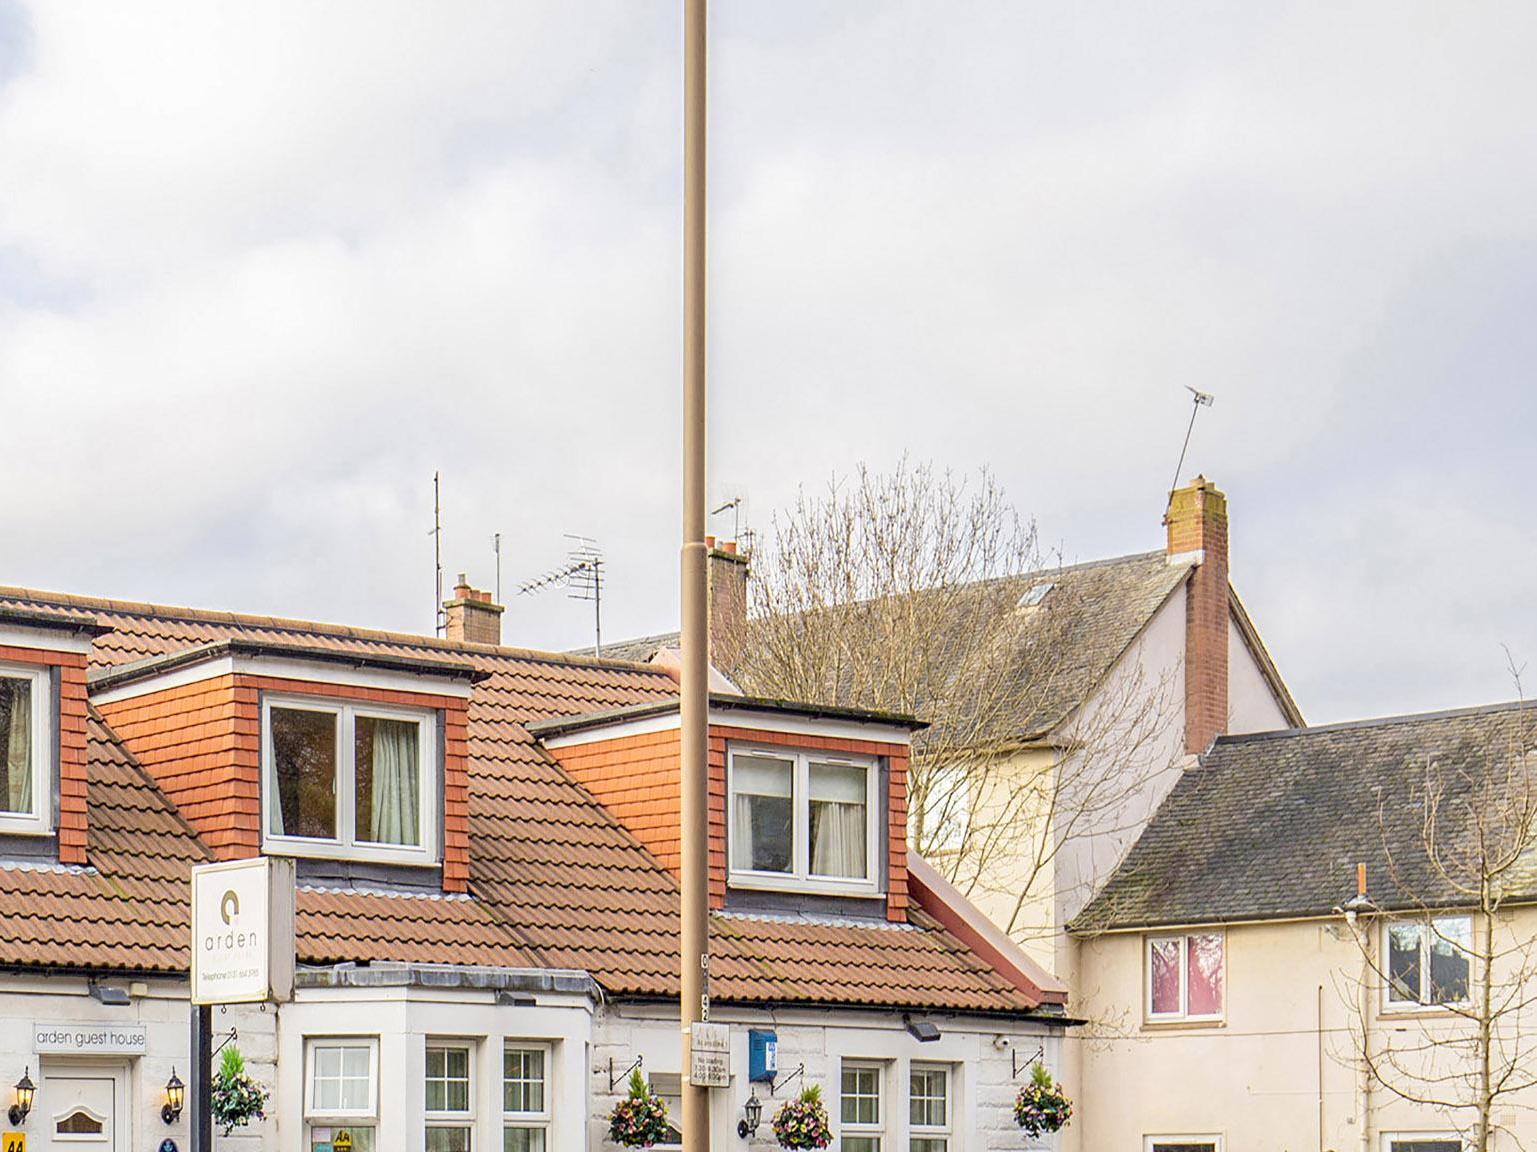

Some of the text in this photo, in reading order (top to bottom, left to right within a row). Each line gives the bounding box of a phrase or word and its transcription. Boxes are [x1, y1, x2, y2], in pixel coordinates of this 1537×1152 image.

[205, 930, 257, 951] arden
[37, 1030, 145, 1047] arden guest house
[335, 1129, 350, 1143] AA
